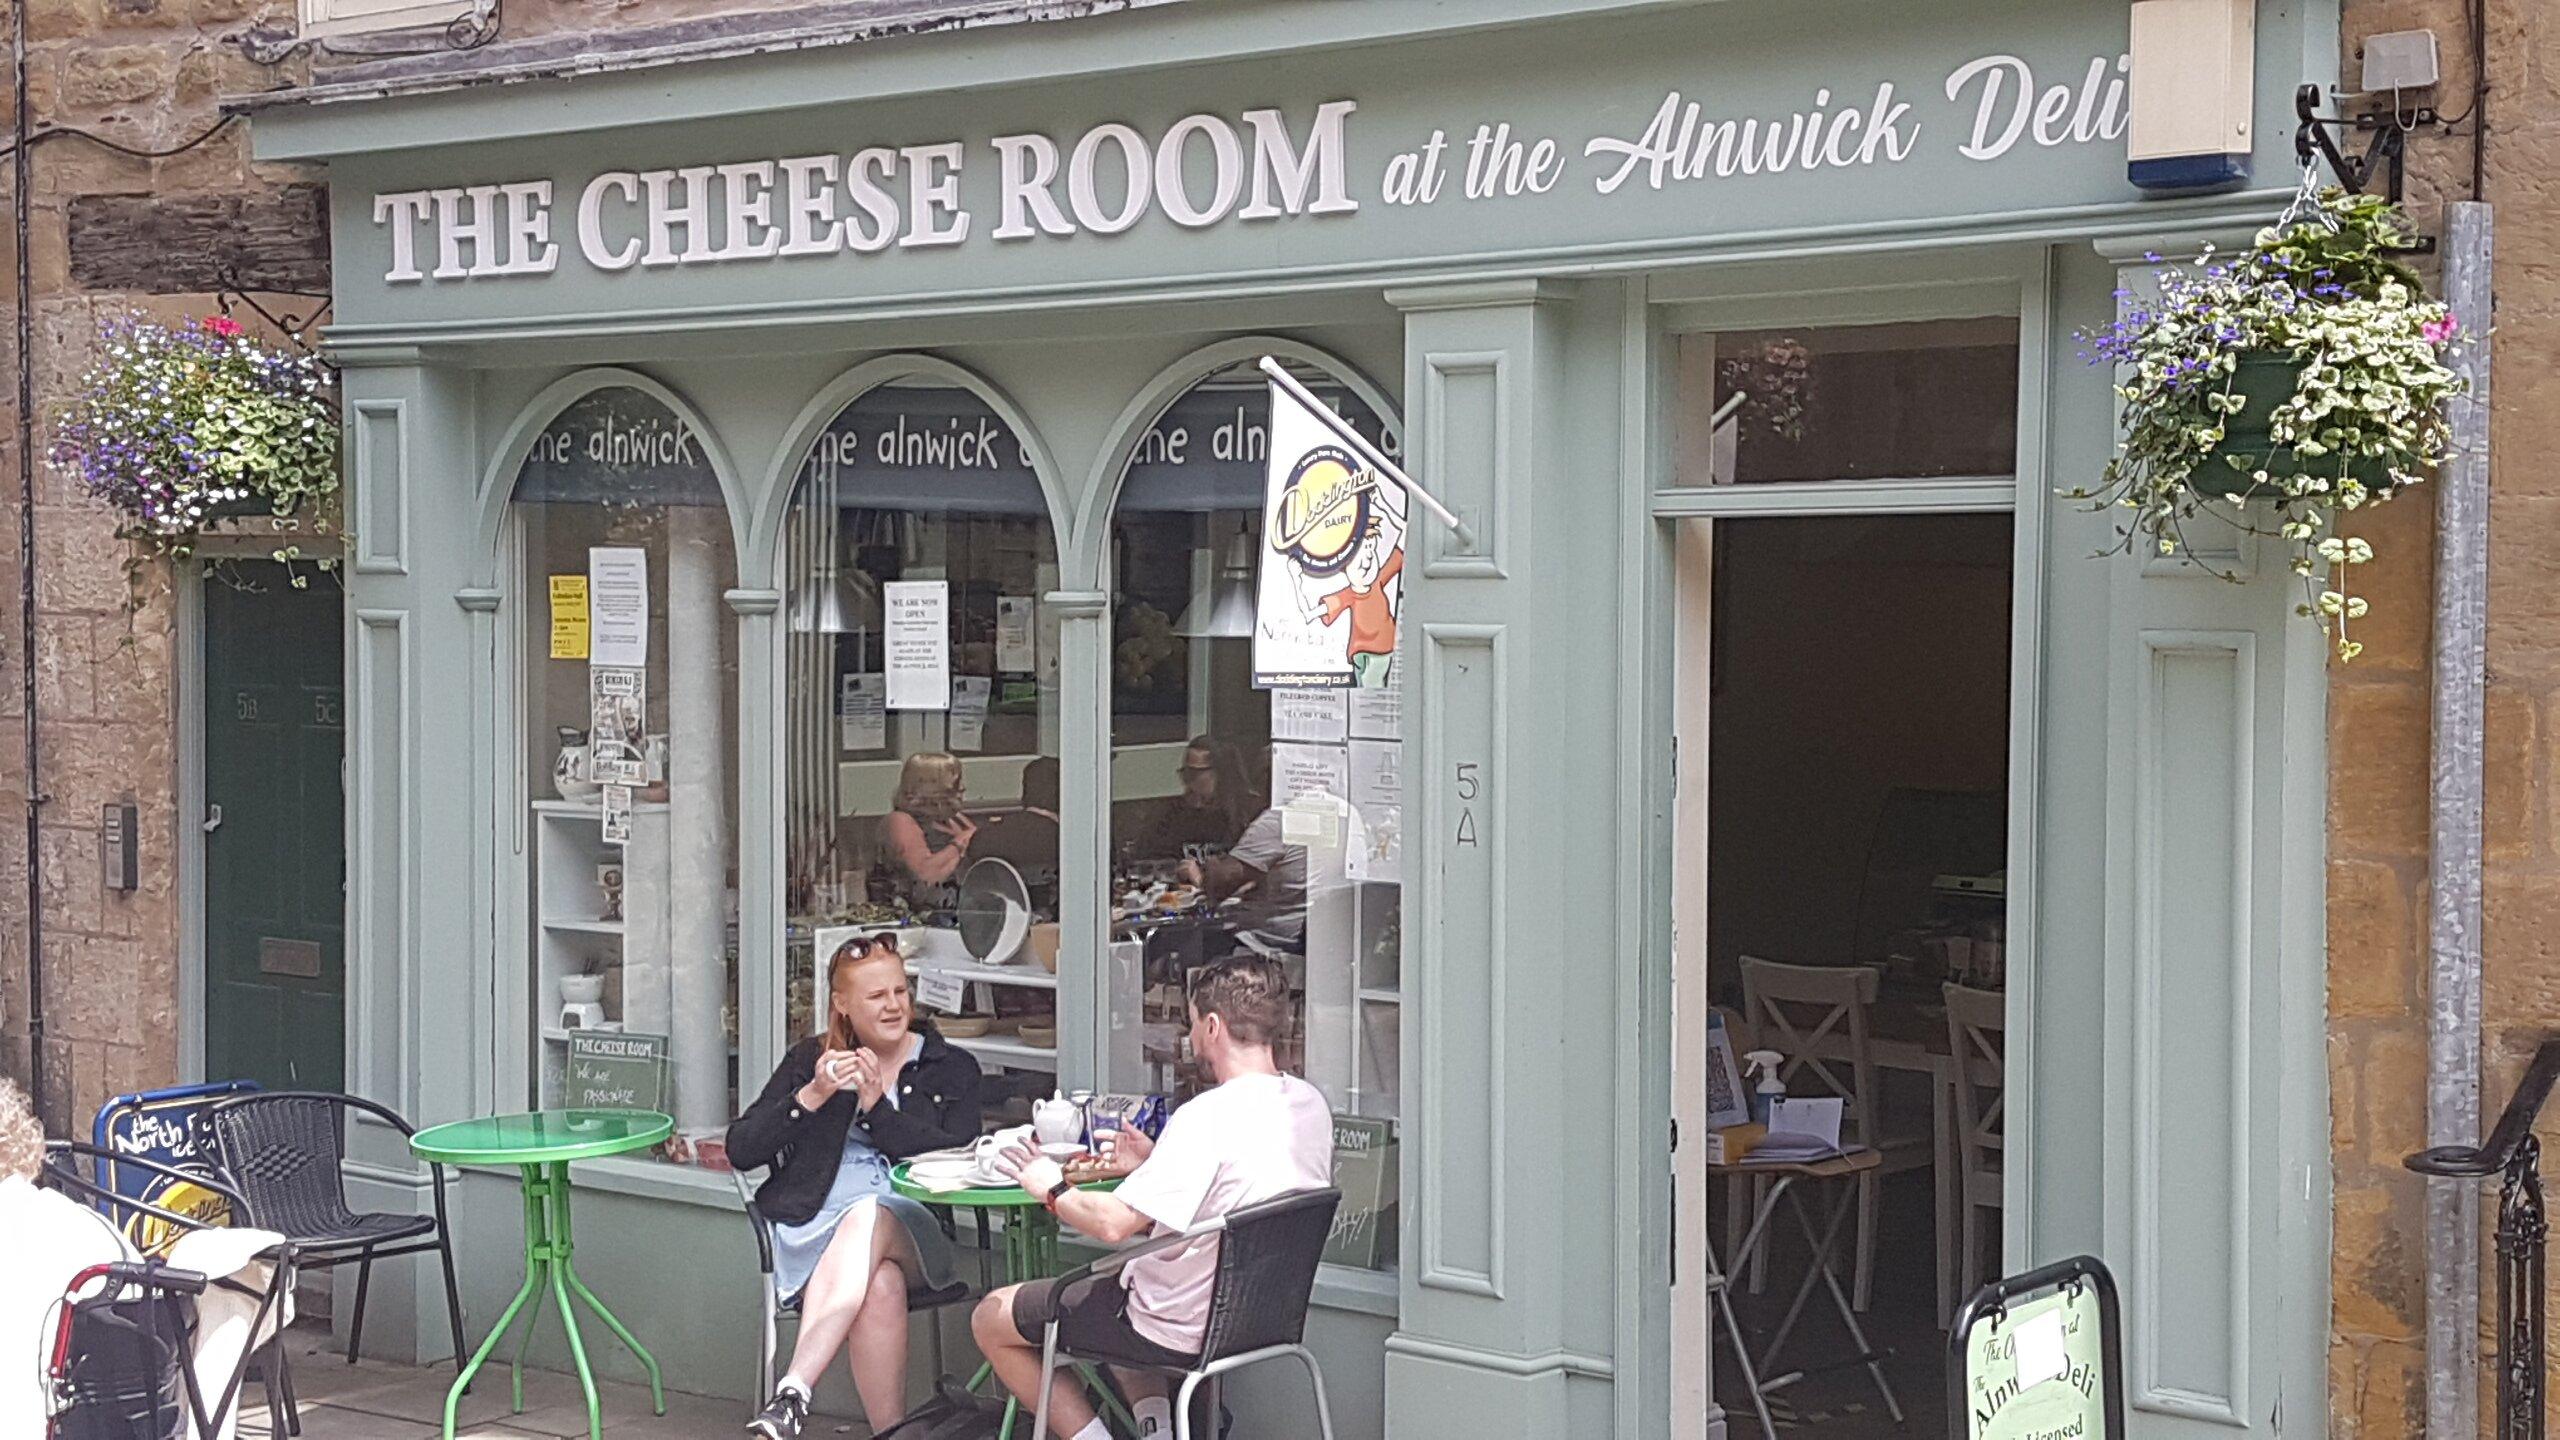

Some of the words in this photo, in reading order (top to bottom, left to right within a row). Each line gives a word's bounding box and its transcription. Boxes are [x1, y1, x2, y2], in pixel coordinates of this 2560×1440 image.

[374, 180, 559, 281] THE
[577, 140, 970, 271] CHEESE
[991, 99, 1359, 238] ROOM
[1382, 129, 1448, 206] at
[1464, 122, 1566, 198] the
[1583, 81, 1922, 194] Alnwick
[1945, 54, 2131, 162] Deli
[588, 414, 698, 469] alnwick
[877, 413, 999, 470] alnwick
[1324, 514, 1353, 529] DAIRY
[906, 598, 919, 607] ARE
[921, 598, 938, 607] NOW
[905, 610, 925, 618] OPEN
[594, 1039, 626, 1056] CHEESE
[627, 1042, 653, 1058] ROOM
[131, 1114, 160, 1134] the
[115, 1119, 183, 1154] North
[1340, 1130, 1371, 1151] ROOM
